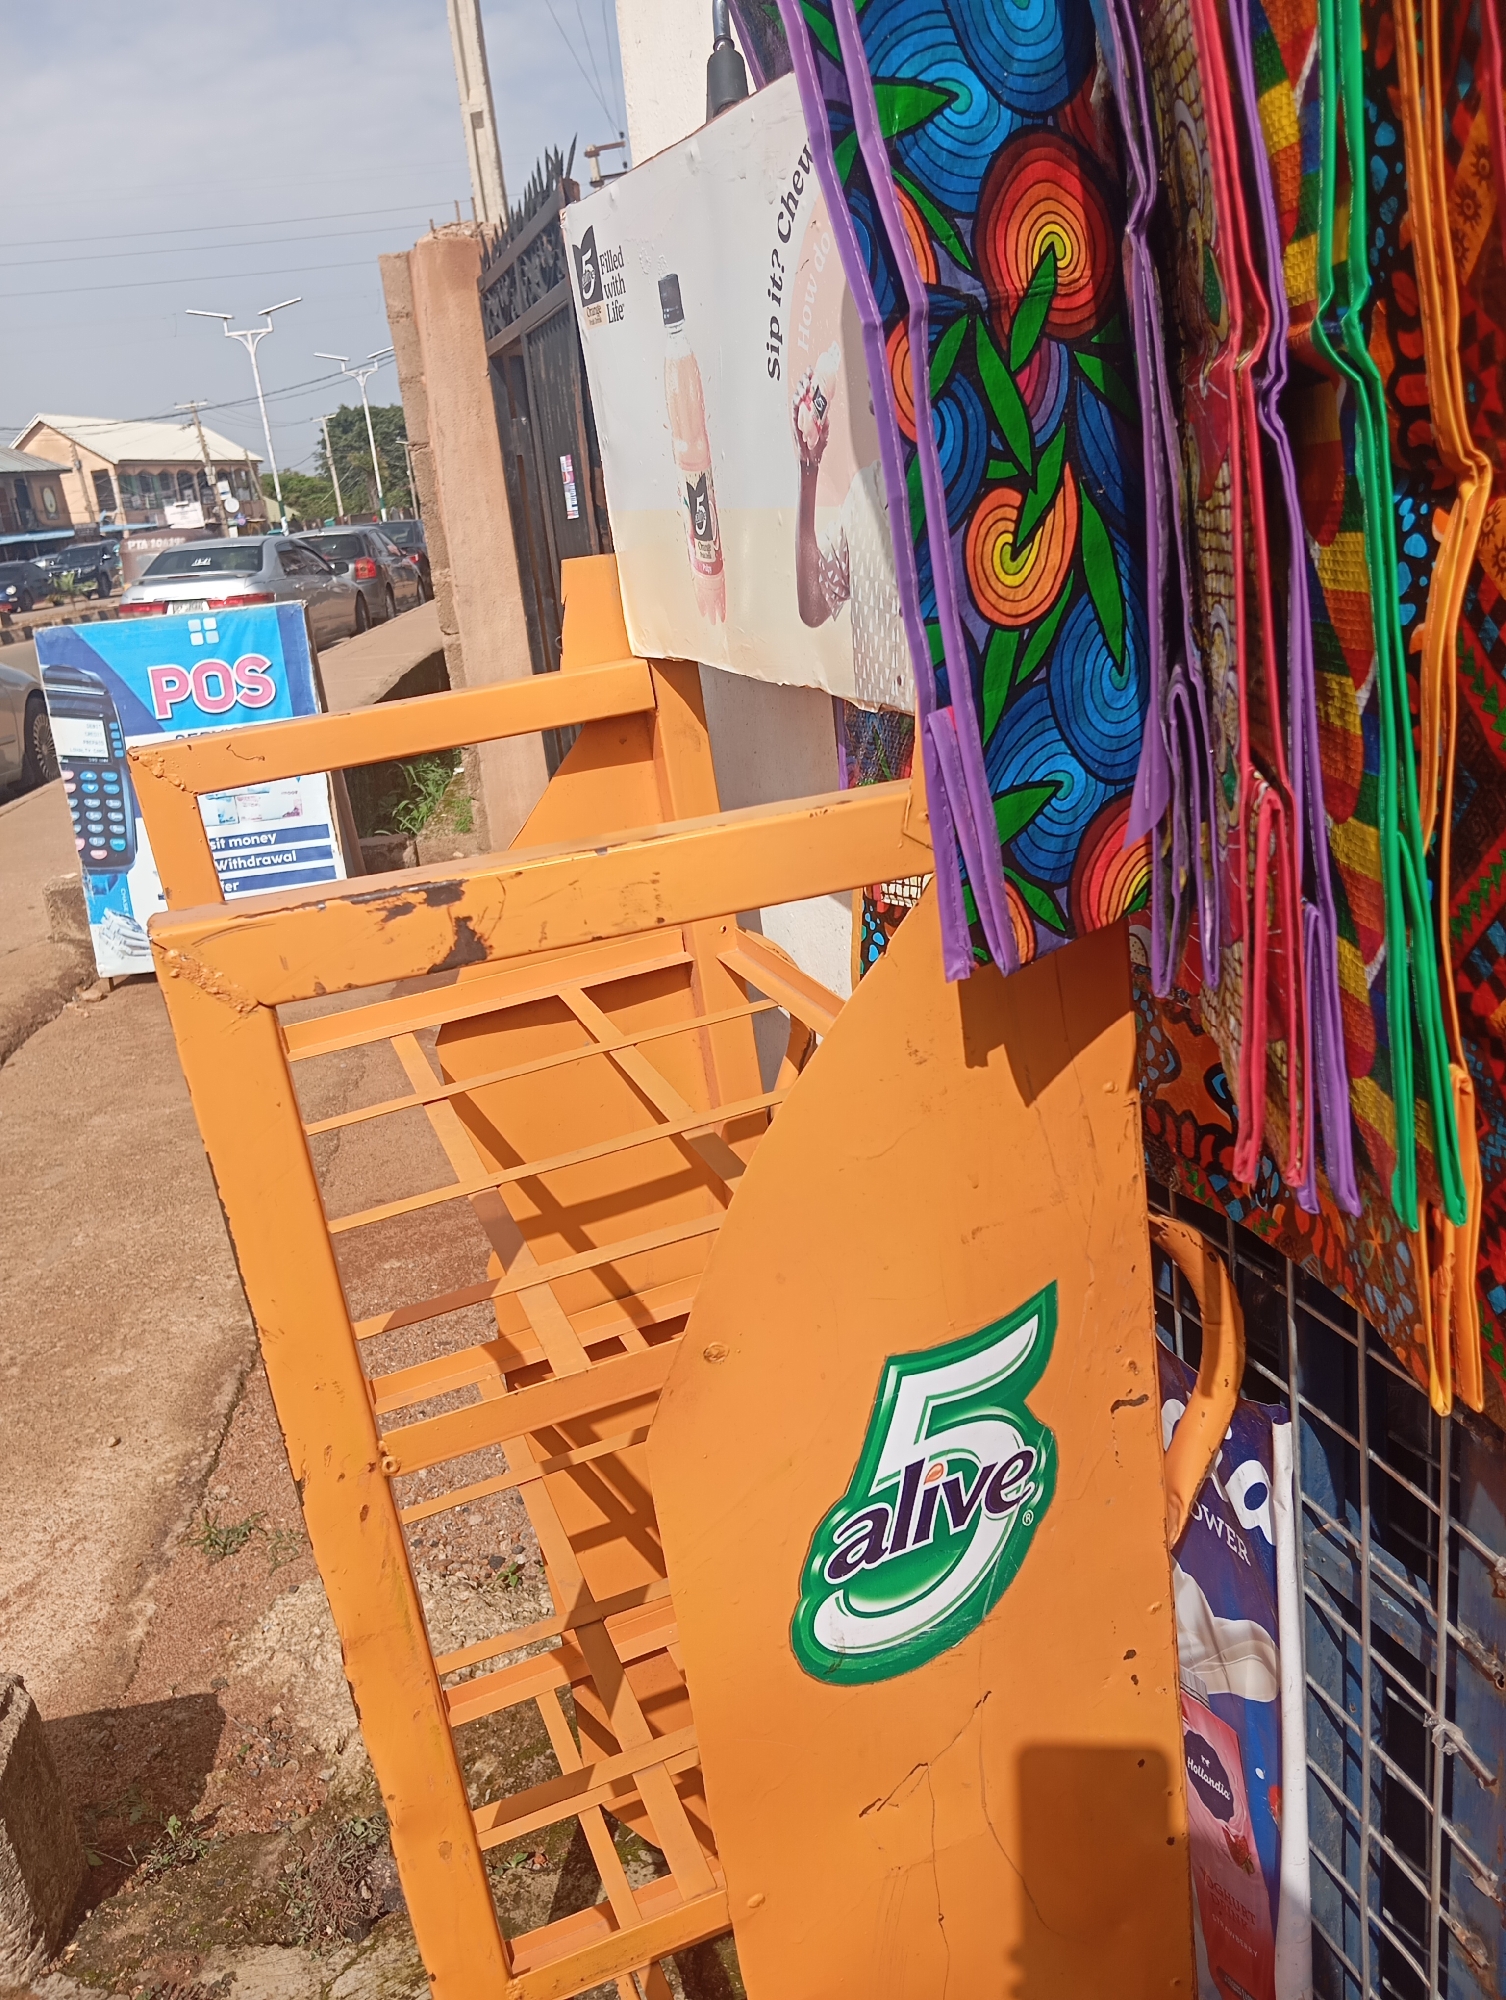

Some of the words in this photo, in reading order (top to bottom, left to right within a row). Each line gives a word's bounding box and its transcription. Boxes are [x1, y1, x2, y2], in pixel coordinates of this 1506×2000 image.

[599, 245, 625, 275] Filled
[603, 273, 627, 299] with
[768, 248, 785, 307] it?
[606, 300, 624, 324] Life
[797, 271, 820, 353] How
[814, 232, 831, 274] do
[767, 315, 784, 381] Sip
[147, 653, 276, 720] POS
[209, 836, 227, 851] sit
[228, 831, 277, 849] money
[214, 850, 297, 872] Withdrawal
[815, 1314, 1039, 1655] 5
[823, 1444, 1038, 1585] alive
[1186, 1755, 1231, 1801] Hollandia
[1199, 1866, 1256, 1926] YOGHURT
